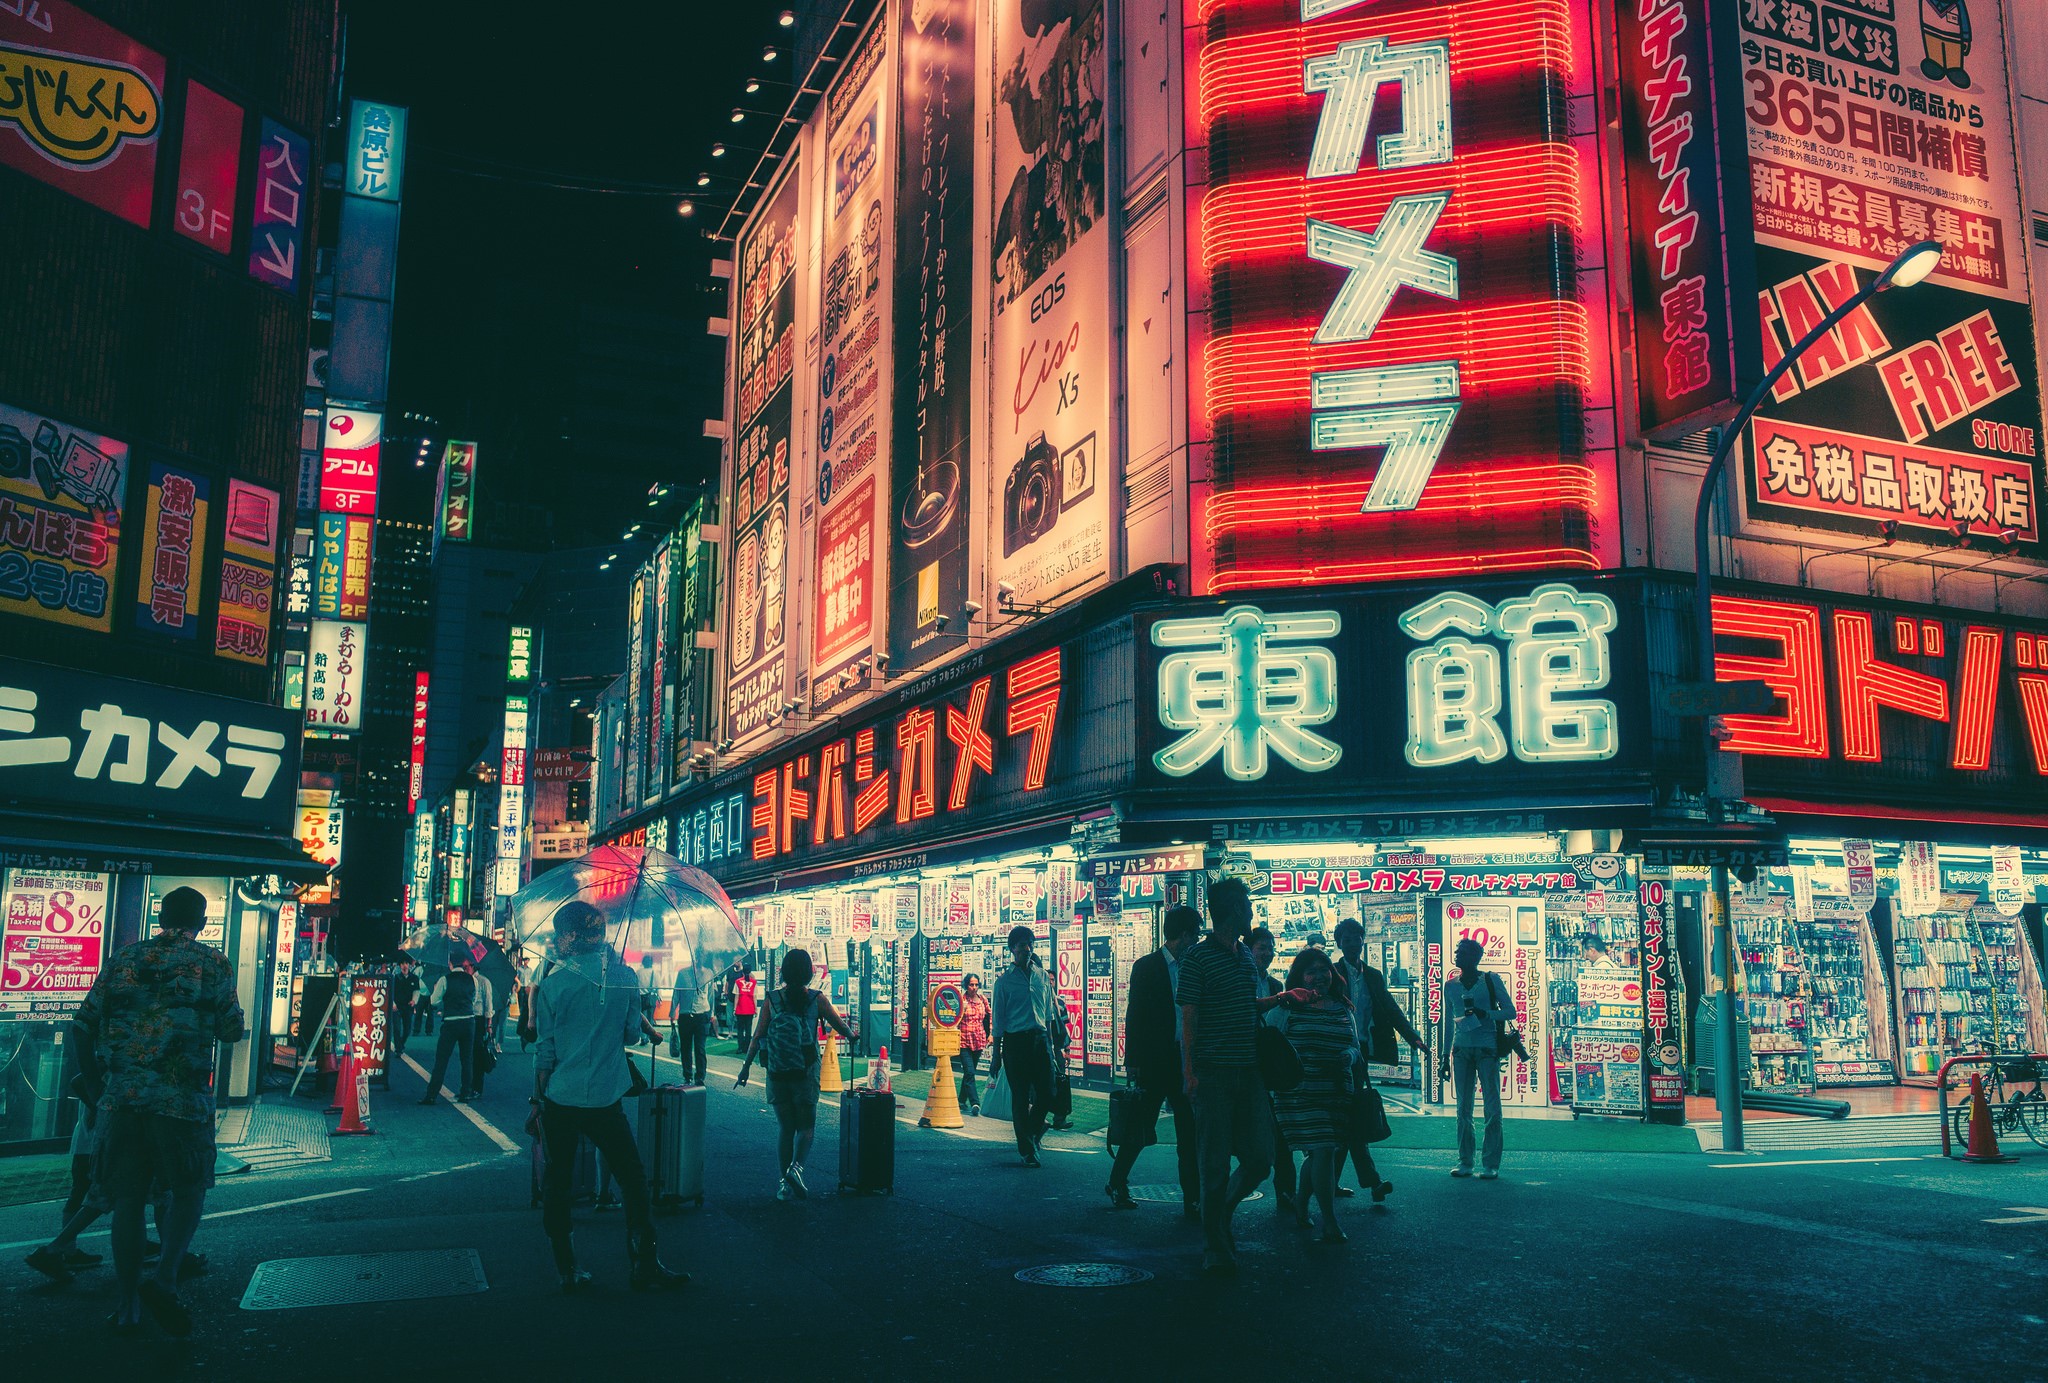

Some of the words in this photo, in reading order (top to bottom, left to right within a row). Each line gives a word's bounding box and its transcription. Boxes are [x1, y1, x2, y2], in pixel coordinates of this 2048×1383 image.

[1745, 0, 1814, 44] 水没
[1827, 17, 1895, 68] 火災
[1741, 39, 1985, 129] 今日お買い上げの商品から
[357, 106, 393, 195] 桑原ビル
[1744, 69, 1990, 183] 365日間補償
[263, 134, 303, 228] 入口
[179, 188, 231, 240] 3F
[1752, 162, 1997, 257] 新規会員募集中
[743, 215, 798, 332] 接客応対
[745, 220, 776, 283] 親切な
[1301, 0, 1462, 513] カメラ
[1030, 271, 1066, 325] EOS
[1758, 258, 1892, 405] TAX
[1012, 320, 1081, 435] Kiss
[1056, 370, 1081, 417] X5
[1876, 308, 2022, 445] FREE
[738, 424, 769, 481] 豊富な
[1972, 418, 2036, 457] STORE
[324, 457, 375, 477] アコム
[446, 449, 471, 533] カラオケ
[736, 437, 789, 532] 品揃え
[1762, 433, 2032, 530] 免税品取扱店
[335, 492, 361, 509] 3F
[150, 473, 198, 629] 激安販売
[222, 562, 272, 589] パソコン
[344, 520, 370, 597] 買取販売
[821, 520, 872, 595] 新規会員
[1067, 550, 1080, 573] X5
[0, 551, 107, 614] 2号店
[221, 580, 270, 613] Mac
[824, 575, 864, 637] 募集中
[340, 603, 367, 617] 2F
[919, 606, 938, 625] Nikon
[217, 615, 266, 659] 買取
[730, 660, 784, 717] ヨドバシカメラ
[1151, 583, 1619, 781] 東館
[306, 708, 327, 724] B1
[412, 684, 428, 746] カラオケ
[0, 686, 286, 800] シカメラ
[752, 645, 1062, 862] ヨドバシカメラ
[1211, 820, 1364, 840] ヨドバシカメラ
[1094, 852, 1197, 876] ヨドバシカメラ
[1270, 869, 1446, 894] ヨドバシカメラ
[1448, 872, 1578, 891] マルチメディア館
[1646, 849, 1786, 865] ヨドバシカメラ
[1846, 850, 1872, 867] 8%
[11, 899, 42, 917] 免税
[950, 891, 969, 904] 8%
[1850, 878, 1872, 894] 5%
[9, 917, 41, 926] Tax-Free
[45, 890, 103, 935] 8%
[853, 919, 871, 932] 5%
[950, 910, 968, 923] 5%
[5, 951, 55, 989] 5%
[275, 960, 291, 1000] 新高揚
[1058, 951, 1081, 989] 8%
[1427, 943, 1442, 1023] ヨドバシカメラ
[1638, 880, 1669, 1045] 10%ポイント還元!
[369, 987, 388, 1063] らあめん
[1574, 1042, 1620, 1053] ザ・ポイント
[1574, 1052, 1621, 1063] ネットワーク
[1651, 1078, 1682, 1090] 新規会員
[1654, 1089, 1680, 1099] 募集中
